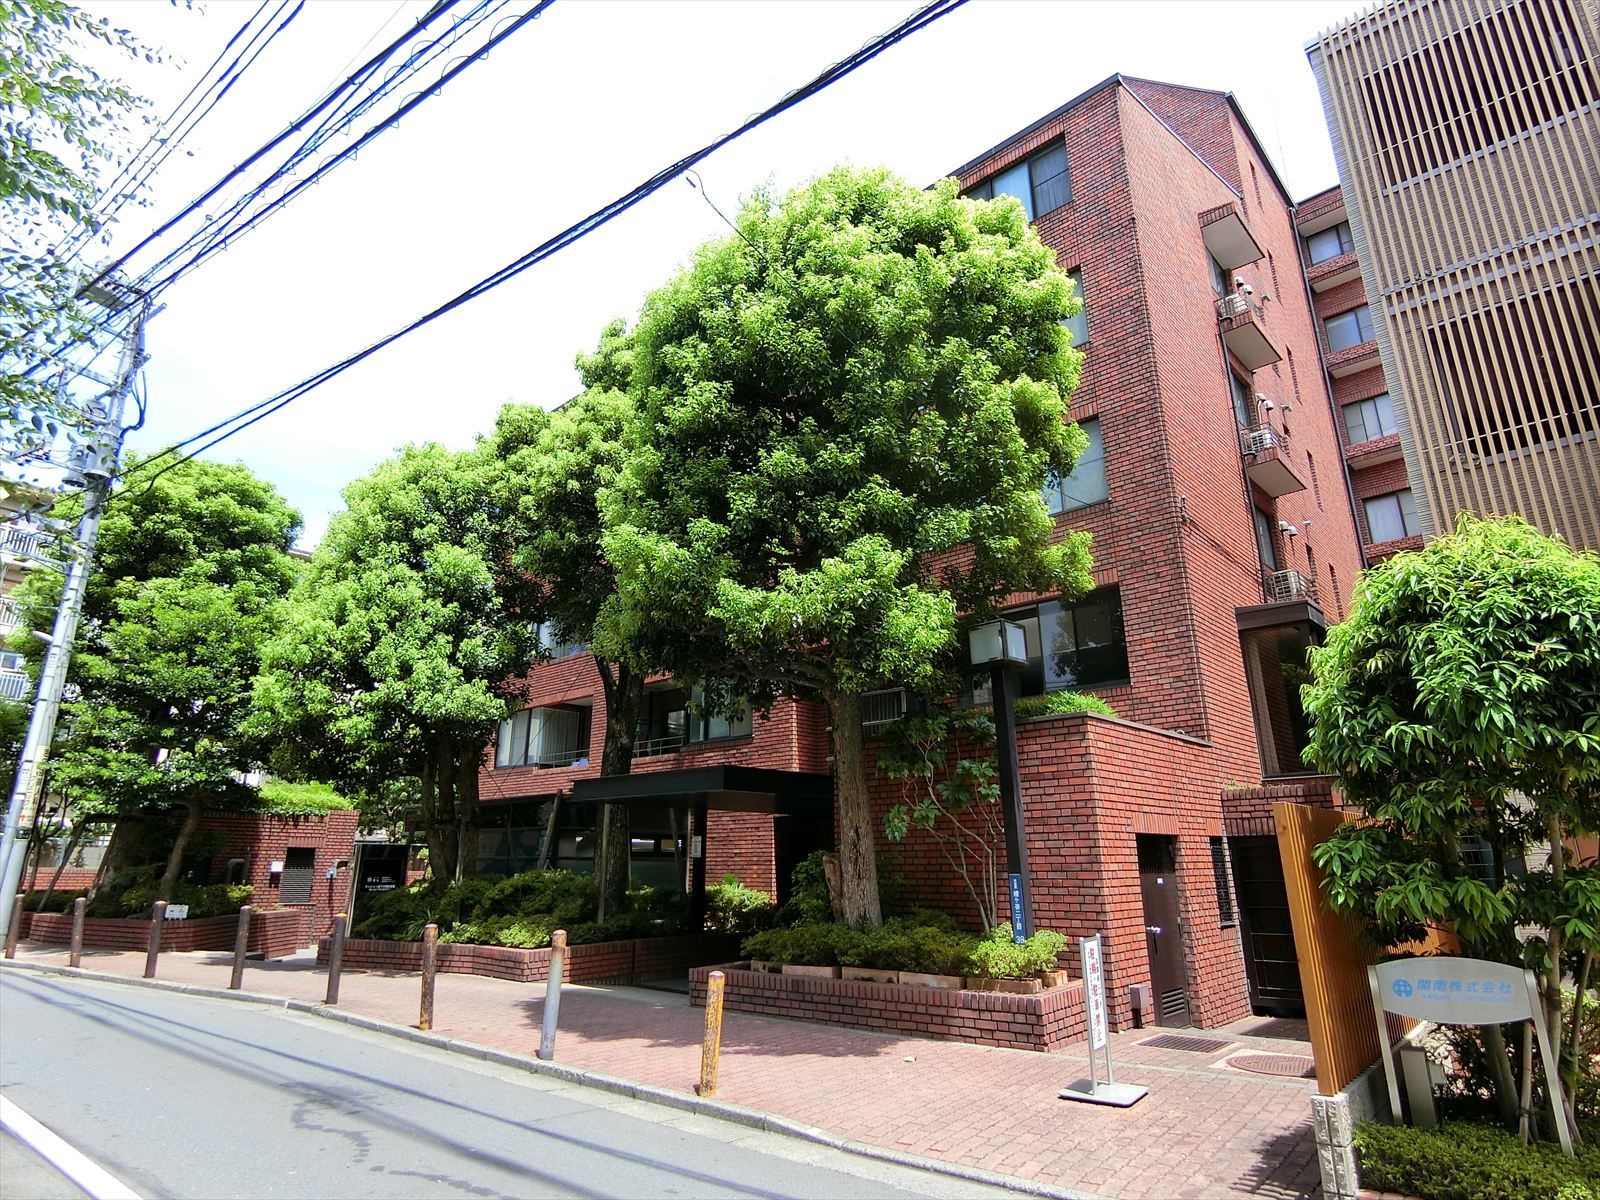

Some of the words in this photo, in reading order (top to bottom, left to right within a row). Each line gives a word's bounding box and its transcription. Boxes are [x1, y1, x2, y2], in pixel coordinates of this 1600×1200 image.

[1015, 935, 1025, 944] 39
[1417, 979, 1512, 994] 開南株式会社
[1453, 995, 1513, 1004] CORPORATION
